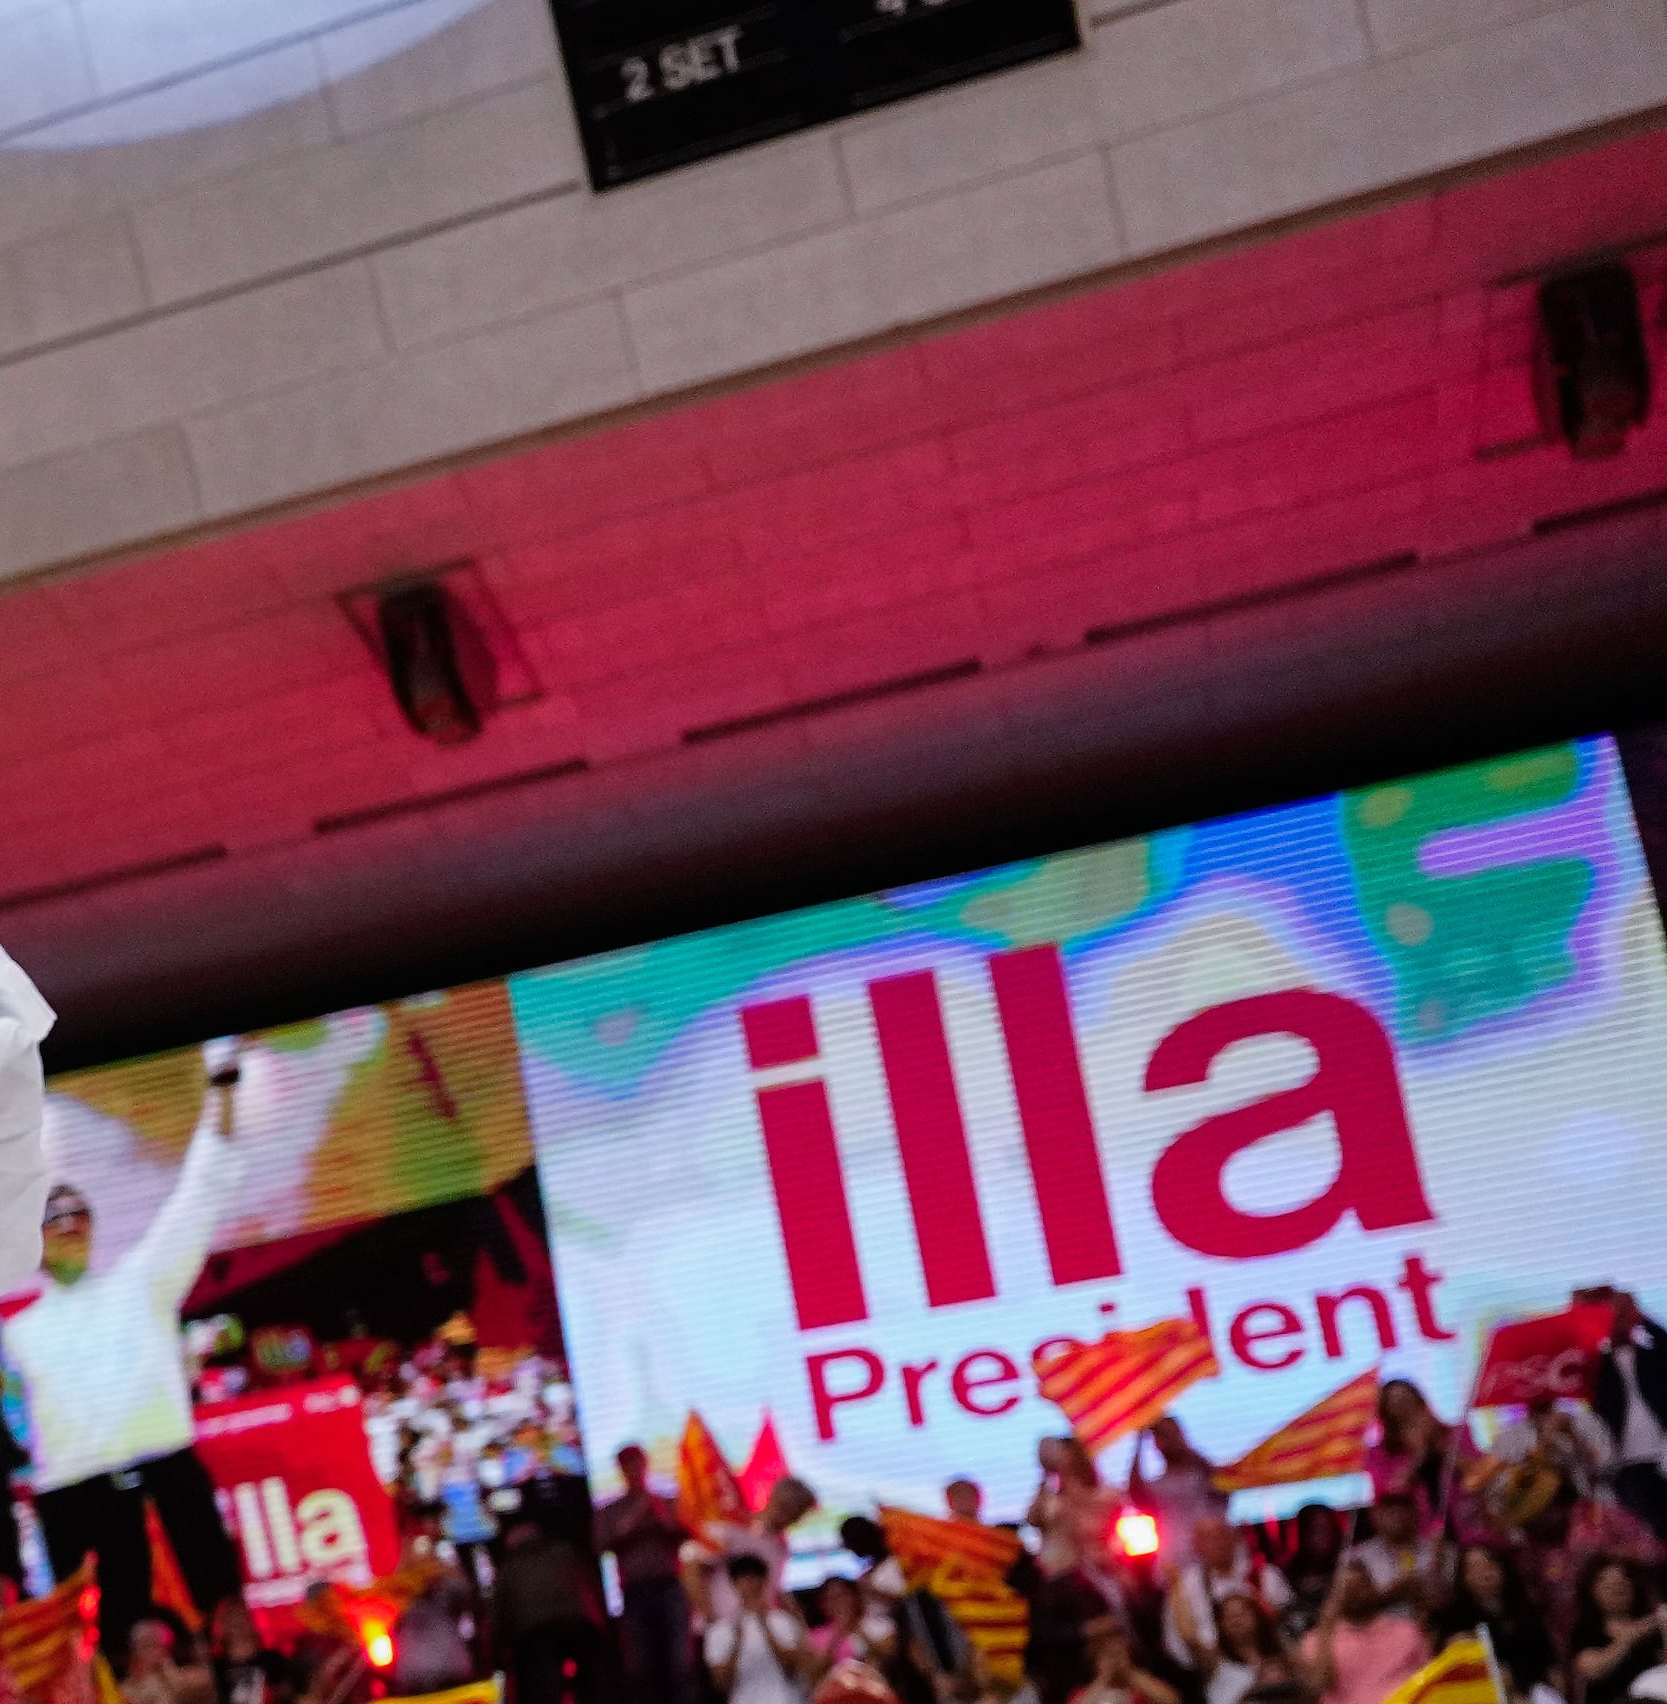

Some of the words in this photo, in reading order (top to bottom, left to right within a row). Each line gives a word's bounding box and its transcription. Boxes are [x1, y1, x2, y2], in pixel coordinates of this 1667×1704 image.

[620, 55, 656, 103] 2
[659, 26, 745, 91] SET
[742, 942, 1435, 1330] illa
[806, 1256, 1457, 1441] Preent
